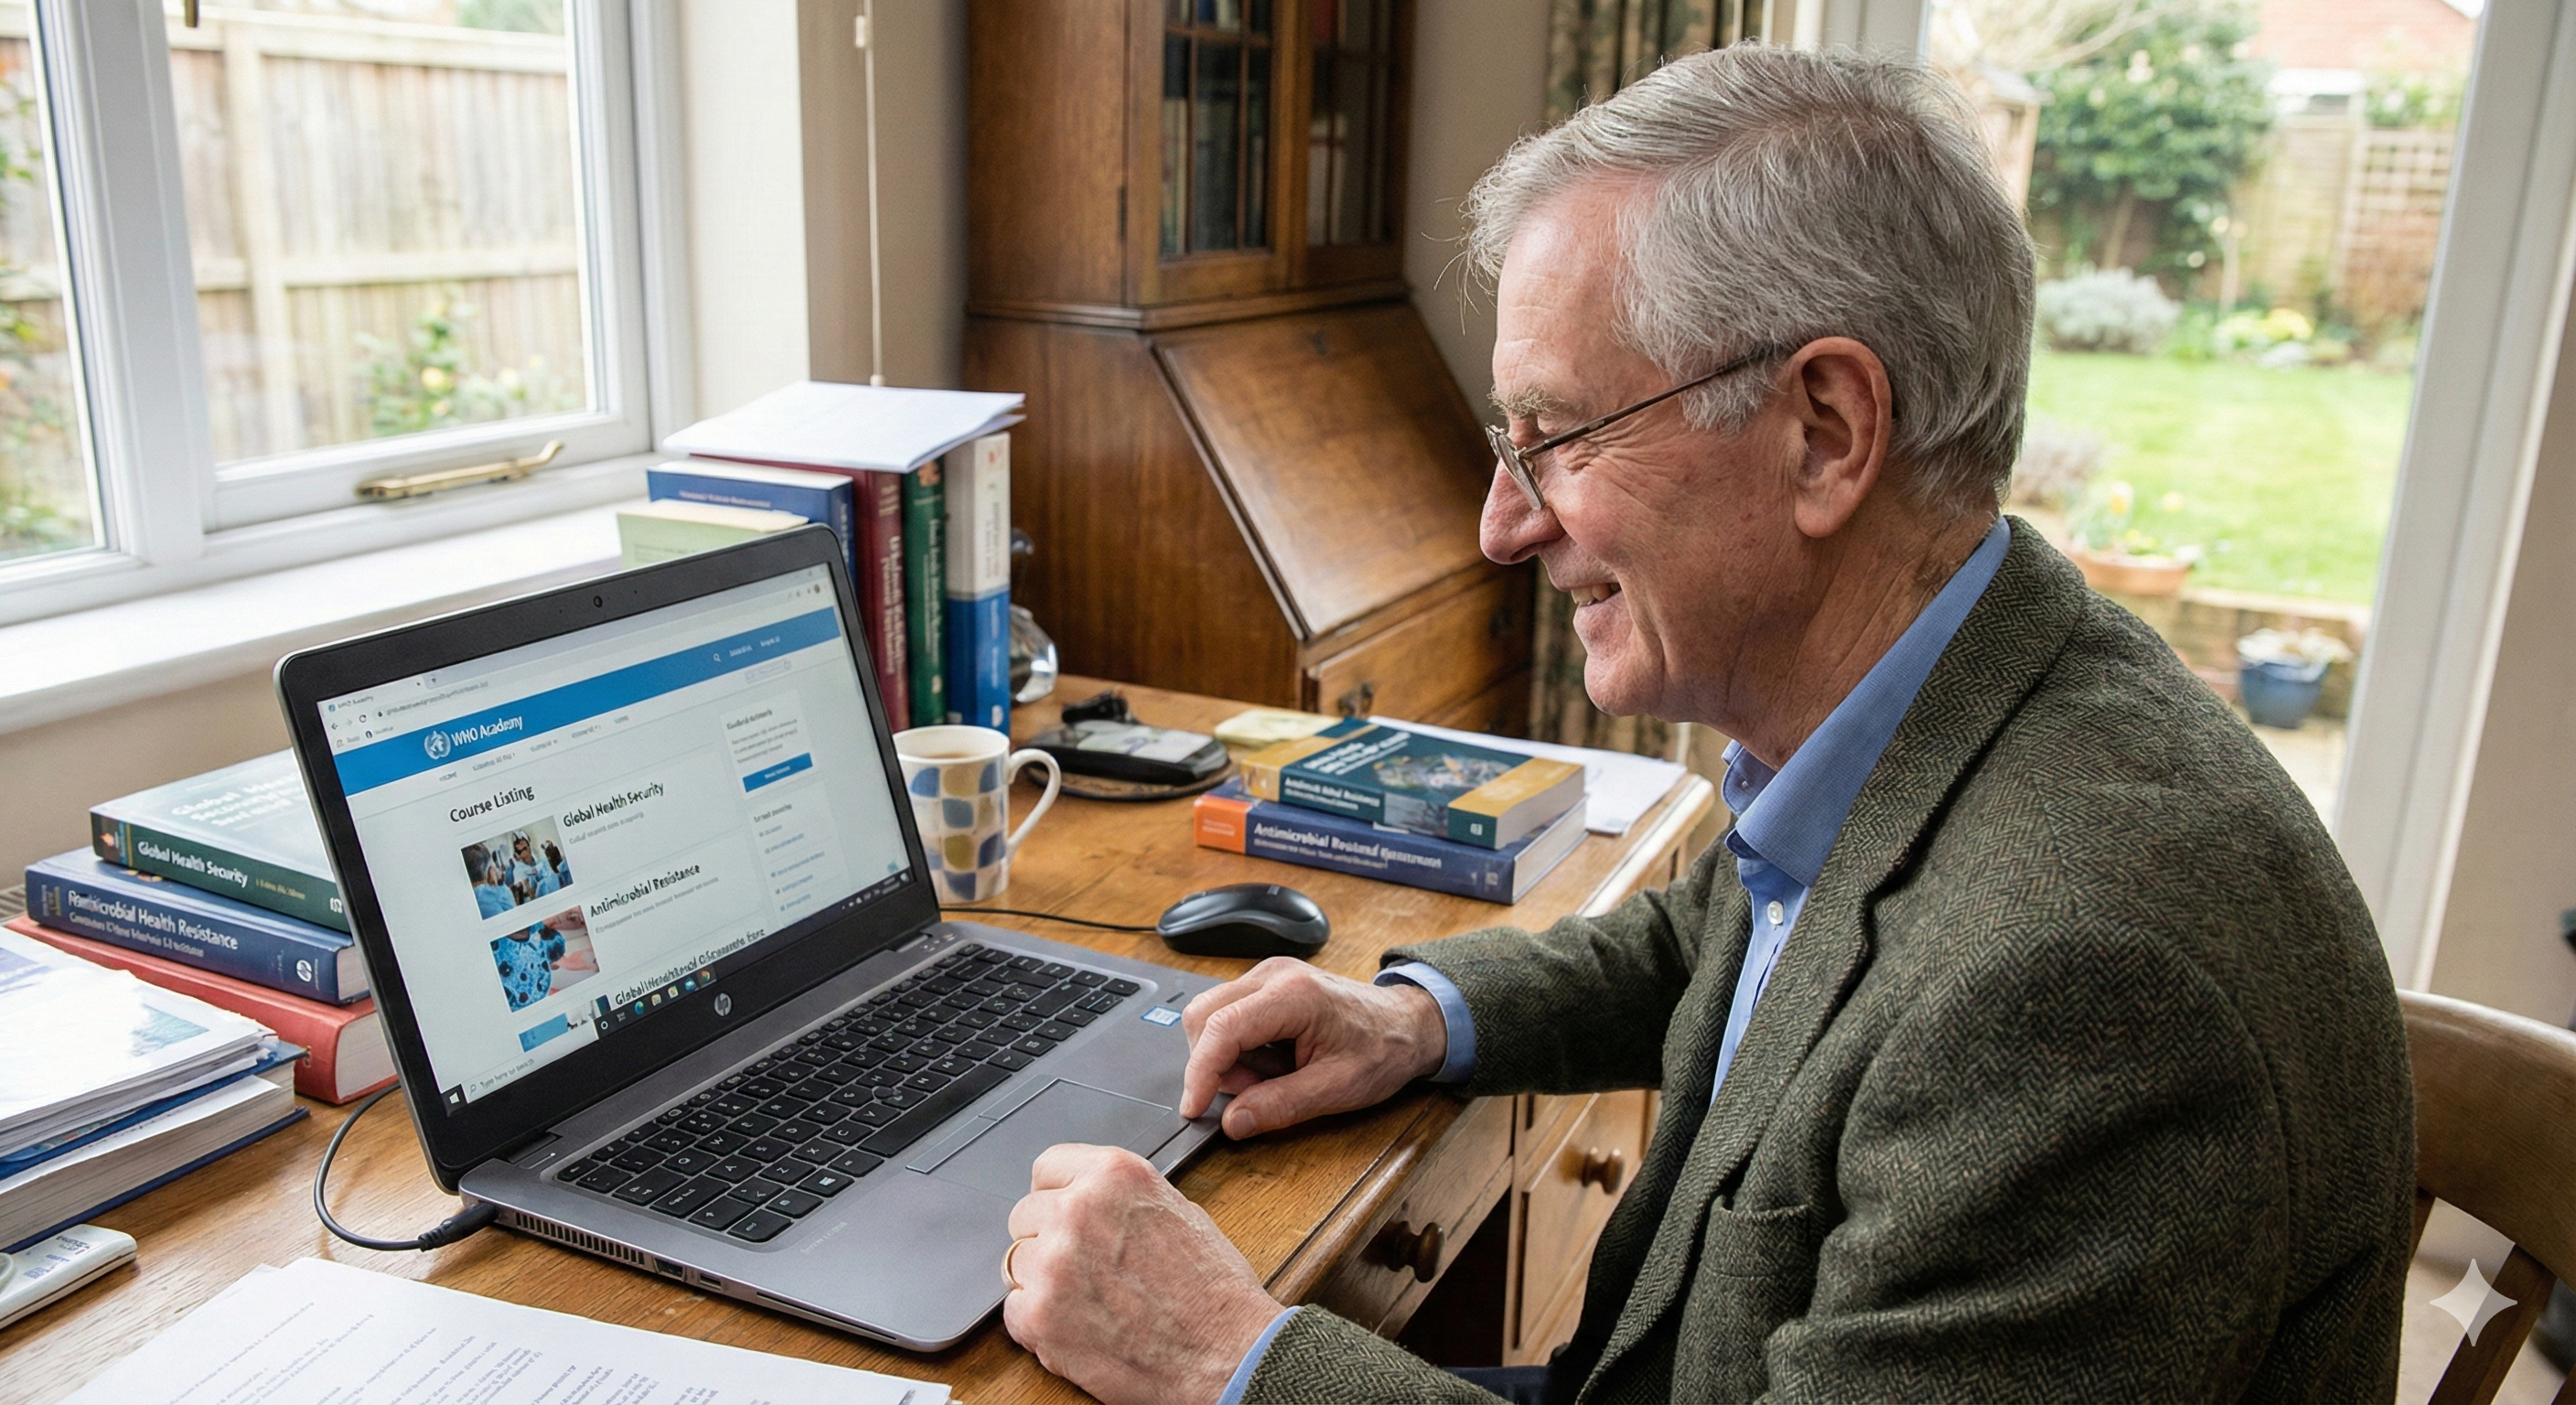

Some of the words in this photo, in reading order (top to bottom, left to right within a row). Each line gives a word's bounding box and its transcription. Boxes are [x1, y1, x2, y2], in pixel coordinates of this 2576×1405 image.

[450, 800, 492, 822] Course
[494, 787, 534, 808] Listing
[564, 805, 595, 827] Global
[596, 794, 627, 817] Health
[628, 782, 664, 804] Security
[138, 841, 170, 862] Global
[171, 851, 205, 872] Health
[207, 861, 248, 888] Security
[138, 907, 176, 934] Health
[178, 918, 238, 950] Resistance
